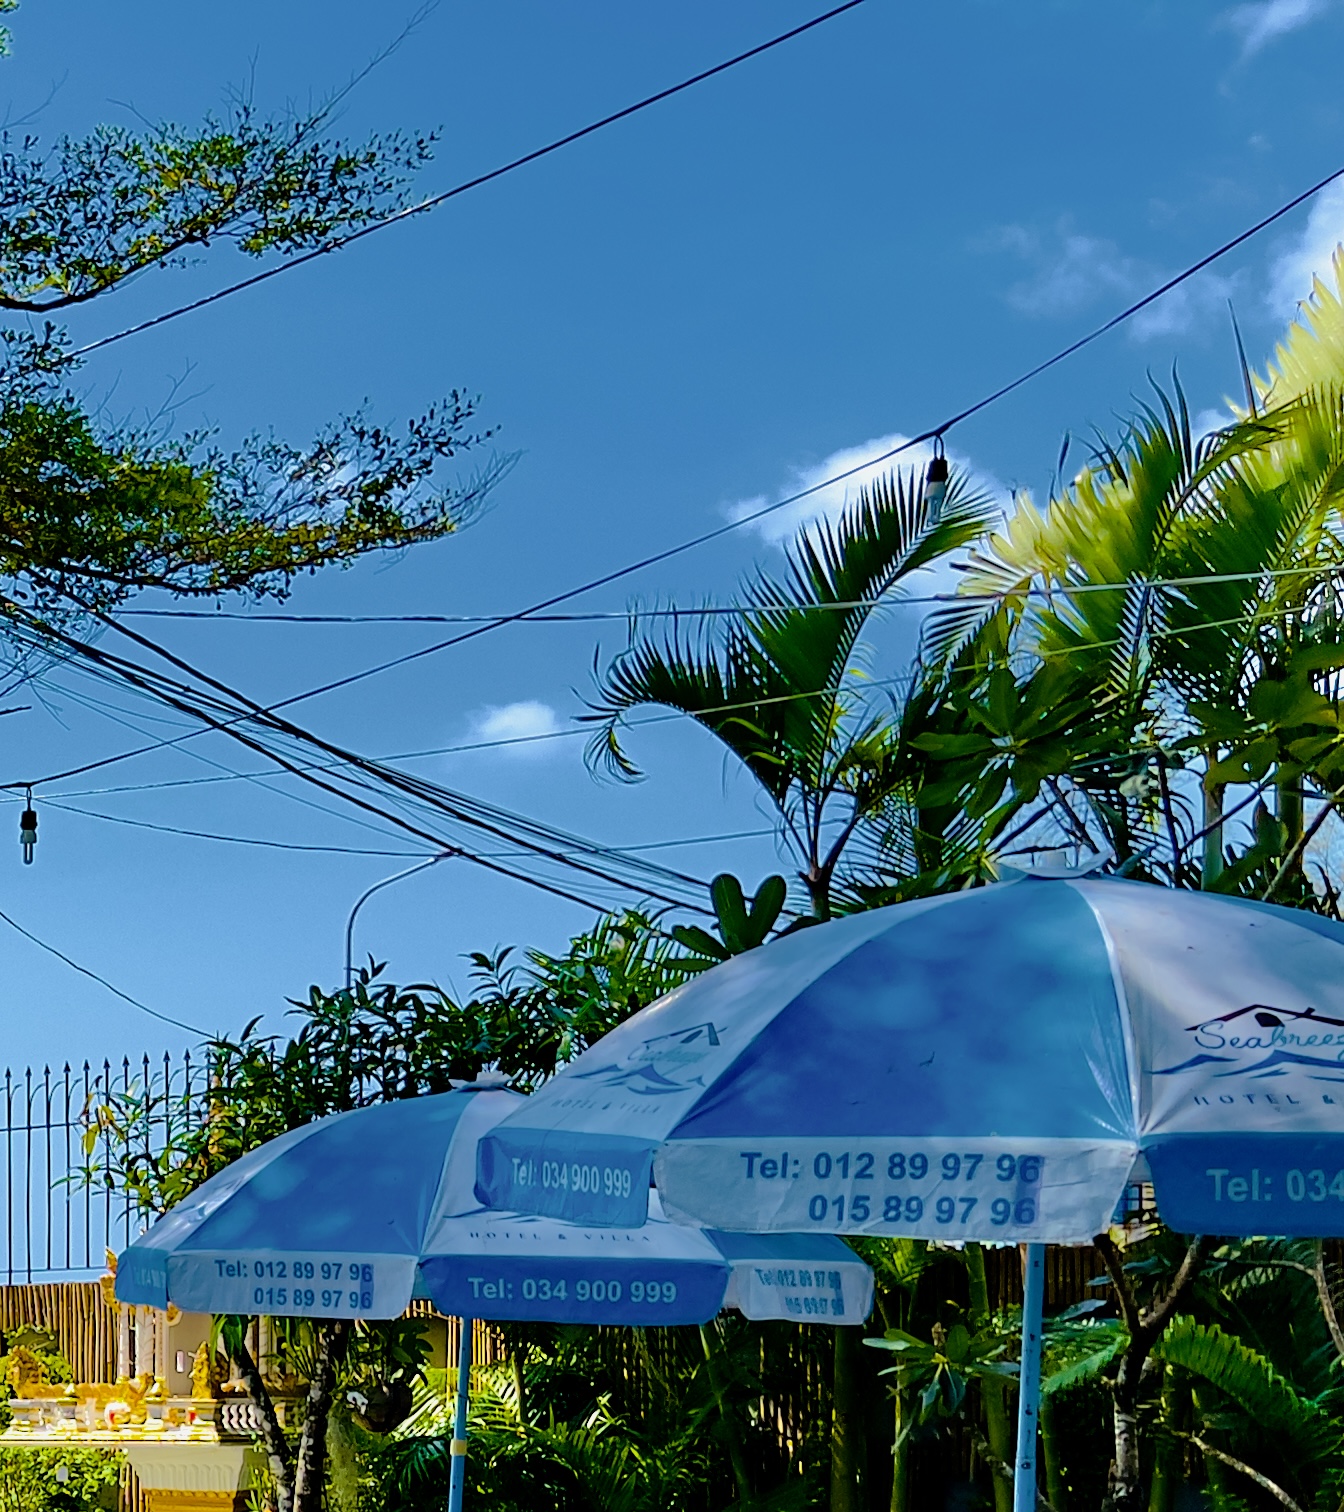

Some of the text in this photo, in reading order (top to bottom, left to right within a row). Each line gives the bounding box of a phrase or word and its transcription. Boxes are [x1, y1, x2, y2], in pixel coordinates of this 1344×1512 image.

[1193, 1093, 1301, 1105] HOTEL
[511, 1157, 631, 1199] Tel: 034 900 999
[740, 1151, 1042, 1183] Tel: 012 89 97 96
[1205, 1168, 1272, 1201] Tel:
[808, 1194, 871, 1222] 015
[882, 1195, 924, 1223] 89
[935, 1196, 979, 1224] 97
[214, 1259, 373, 1284] Tel: 012 89 97 96
[253, 1287, 373, 1310] 015 89 97 96
[468, 1277, 677, 1303] Tel: 034 900 999
